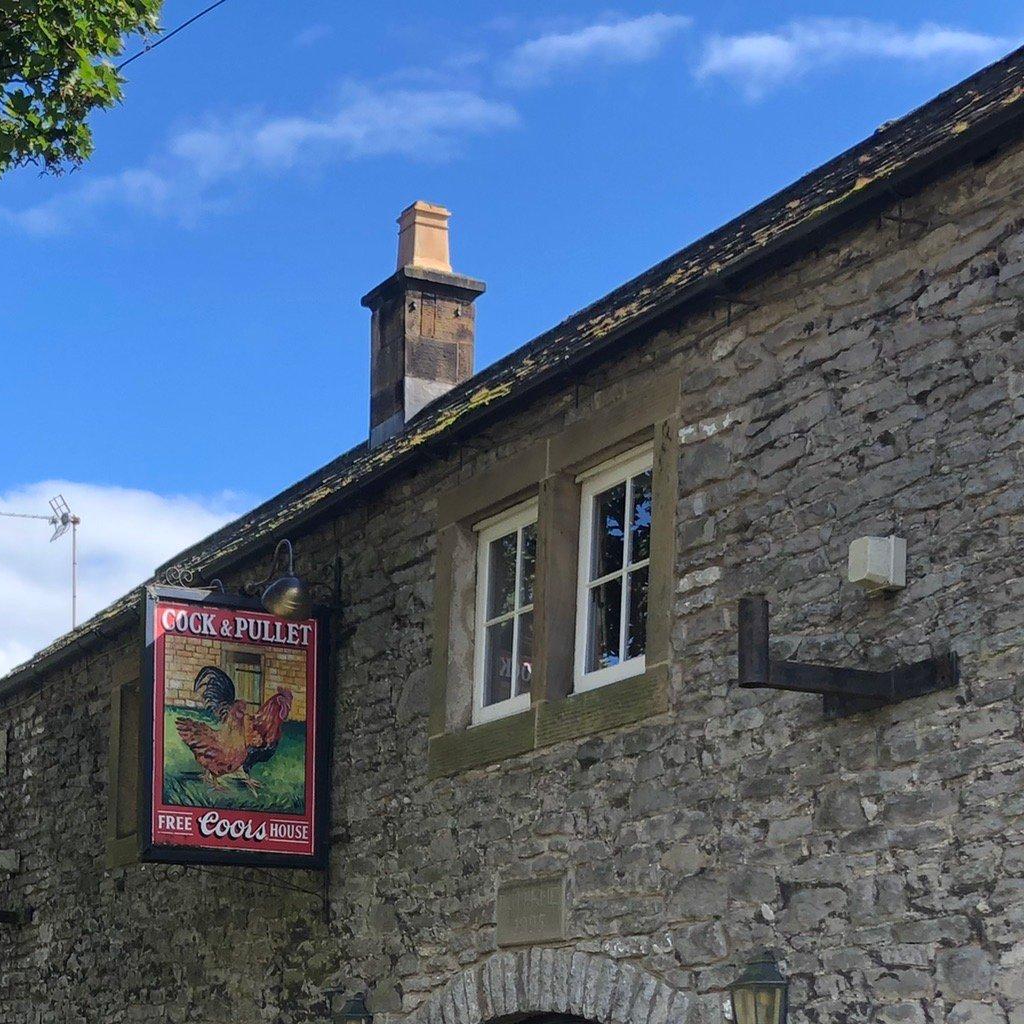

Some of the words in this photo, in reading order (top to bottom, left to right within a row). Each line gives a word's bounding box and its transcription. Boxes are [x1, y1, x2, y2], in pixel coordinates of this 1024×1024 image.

[161, 608, 218, 636] COCK
[220, 618, 233, 638] &
[234, 617, 313, 646] PULLET
[158, 814, 193, 831] FREE
[198, 811, 267, 841] Coors
[270, 823, 309, 840] HOUSE
